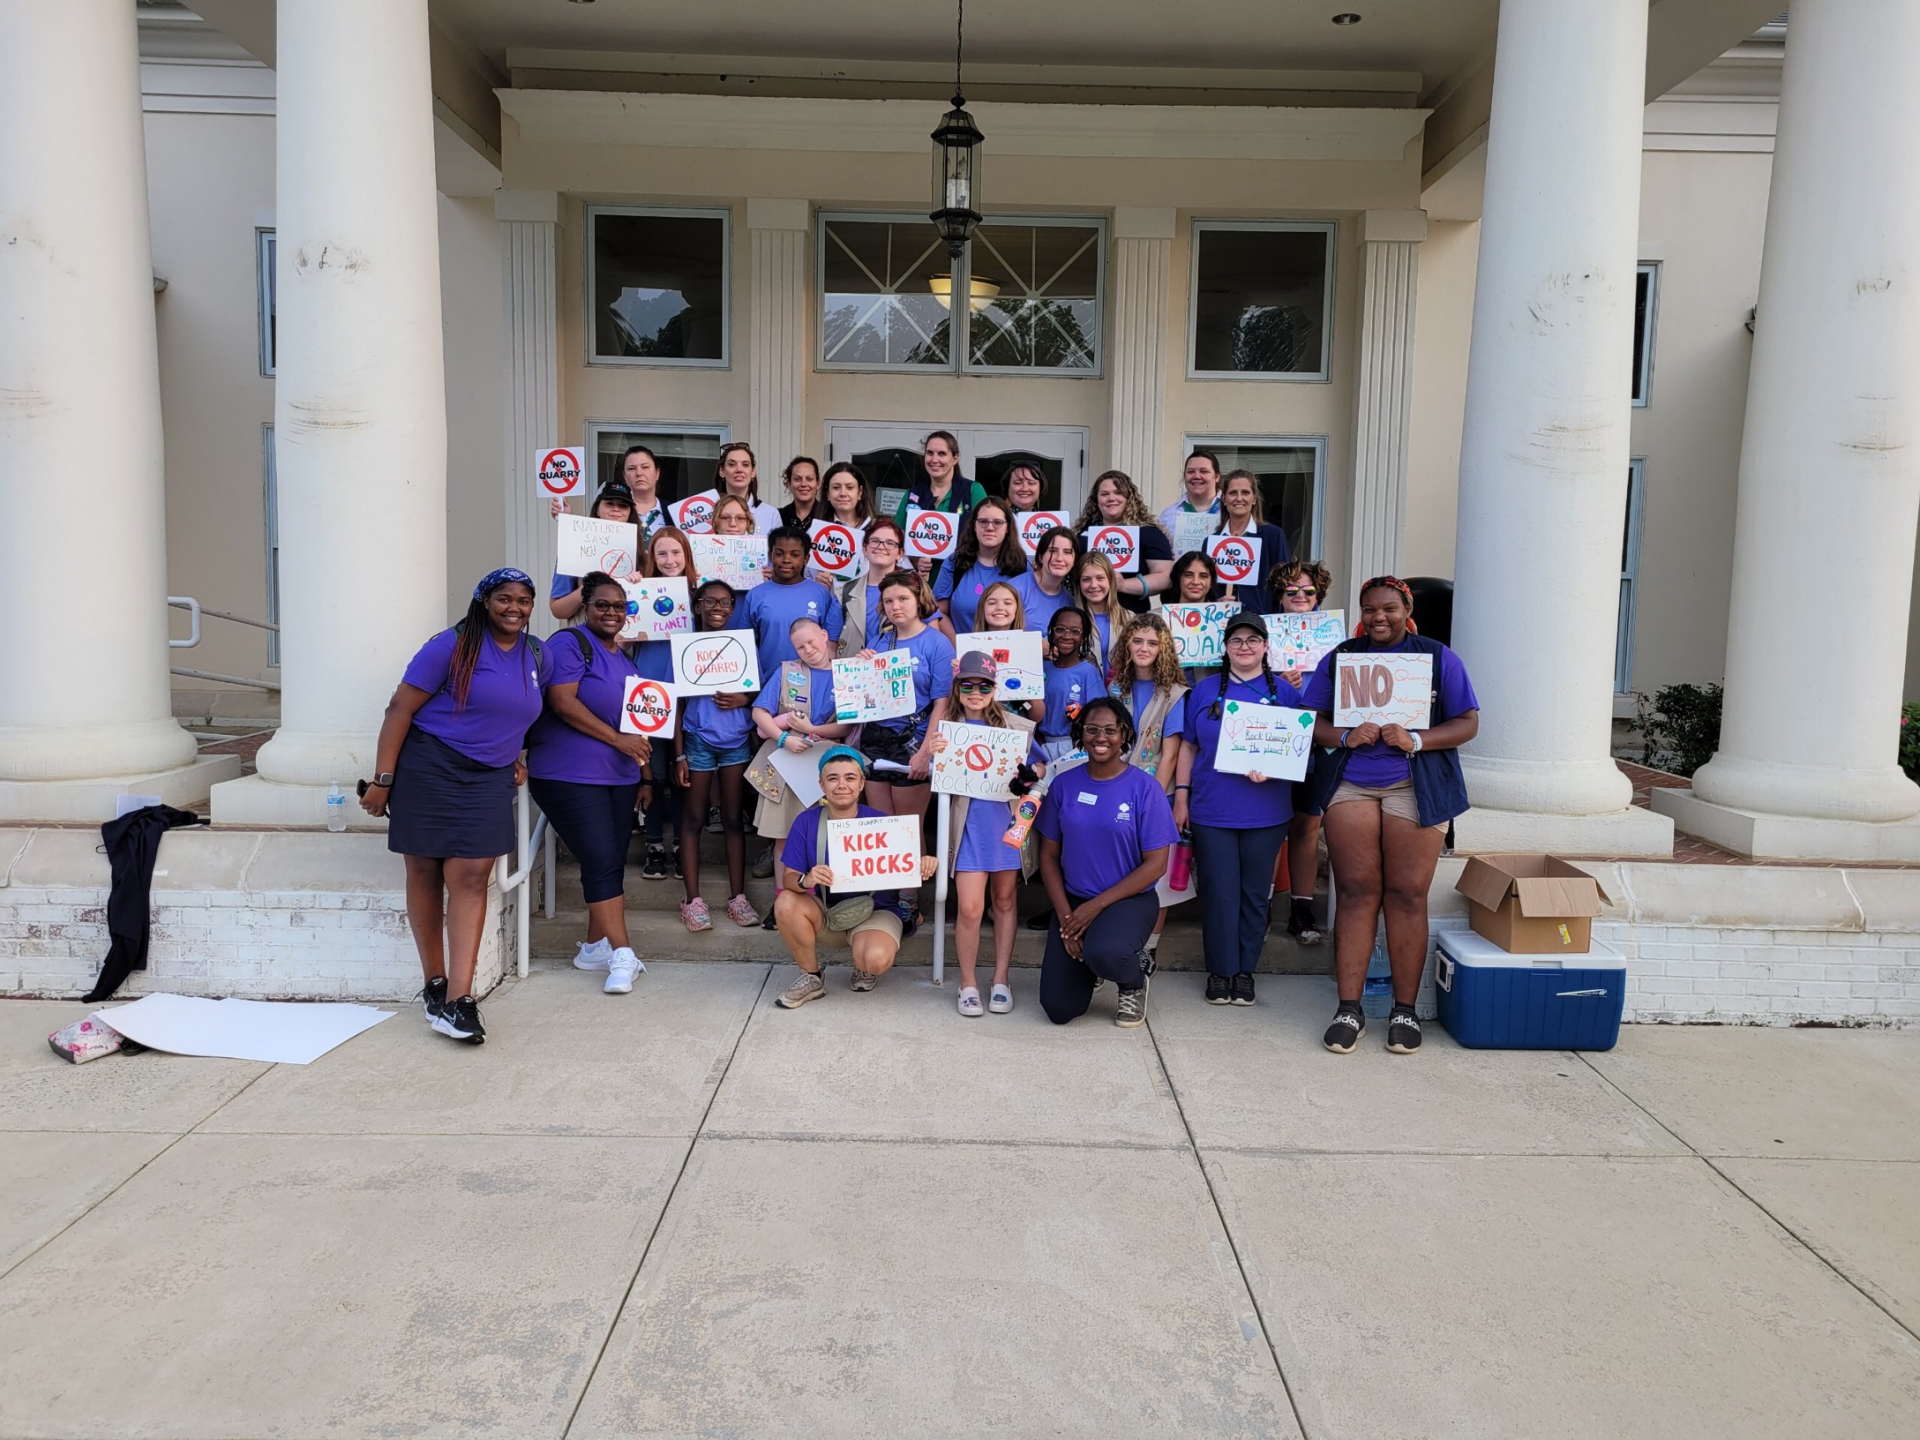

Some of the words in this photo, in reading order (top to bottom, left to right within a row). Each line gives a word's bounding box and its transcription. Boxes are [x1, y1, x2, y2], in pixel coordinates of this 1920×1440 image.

[539, 470, 581, 480] QUARRY
[689, 506, 704, 517] NO
[573, 520, 625, 534] NATURE
[680, 512, 714, 531] QUARR
[924, 522, 939, 530] NO
[827, 535, 843, 545] NO
[908, 531, 953, 542] QUARRY
[1175, 538, 1201, 549] STOP
[810, 542, 856, 559] QUARRY
[653, 615, 688, 632] PLANET
[1168, 609, 1202, 632] NO
[1173, 629, 1226, 658] QUAR
[696, 650, 724, 663] ROCK
[874, 658, 887, 669] NO
[694, 661, 739, 676] QUARRY
[883, 666, 911, 680] PLANET
[891, 680, 907, 698] B!
[1339, 664, 1394, 709] NO
[642, 694, 658, 703] NO
[626, 703, 672, 717] QUARRY
[934, 772, 975, 794] ROCK
[831, 820, 851, 830] THIS
[843, 832, 888, 852] KICK
[851, 852, 914, 877] ROCKS
